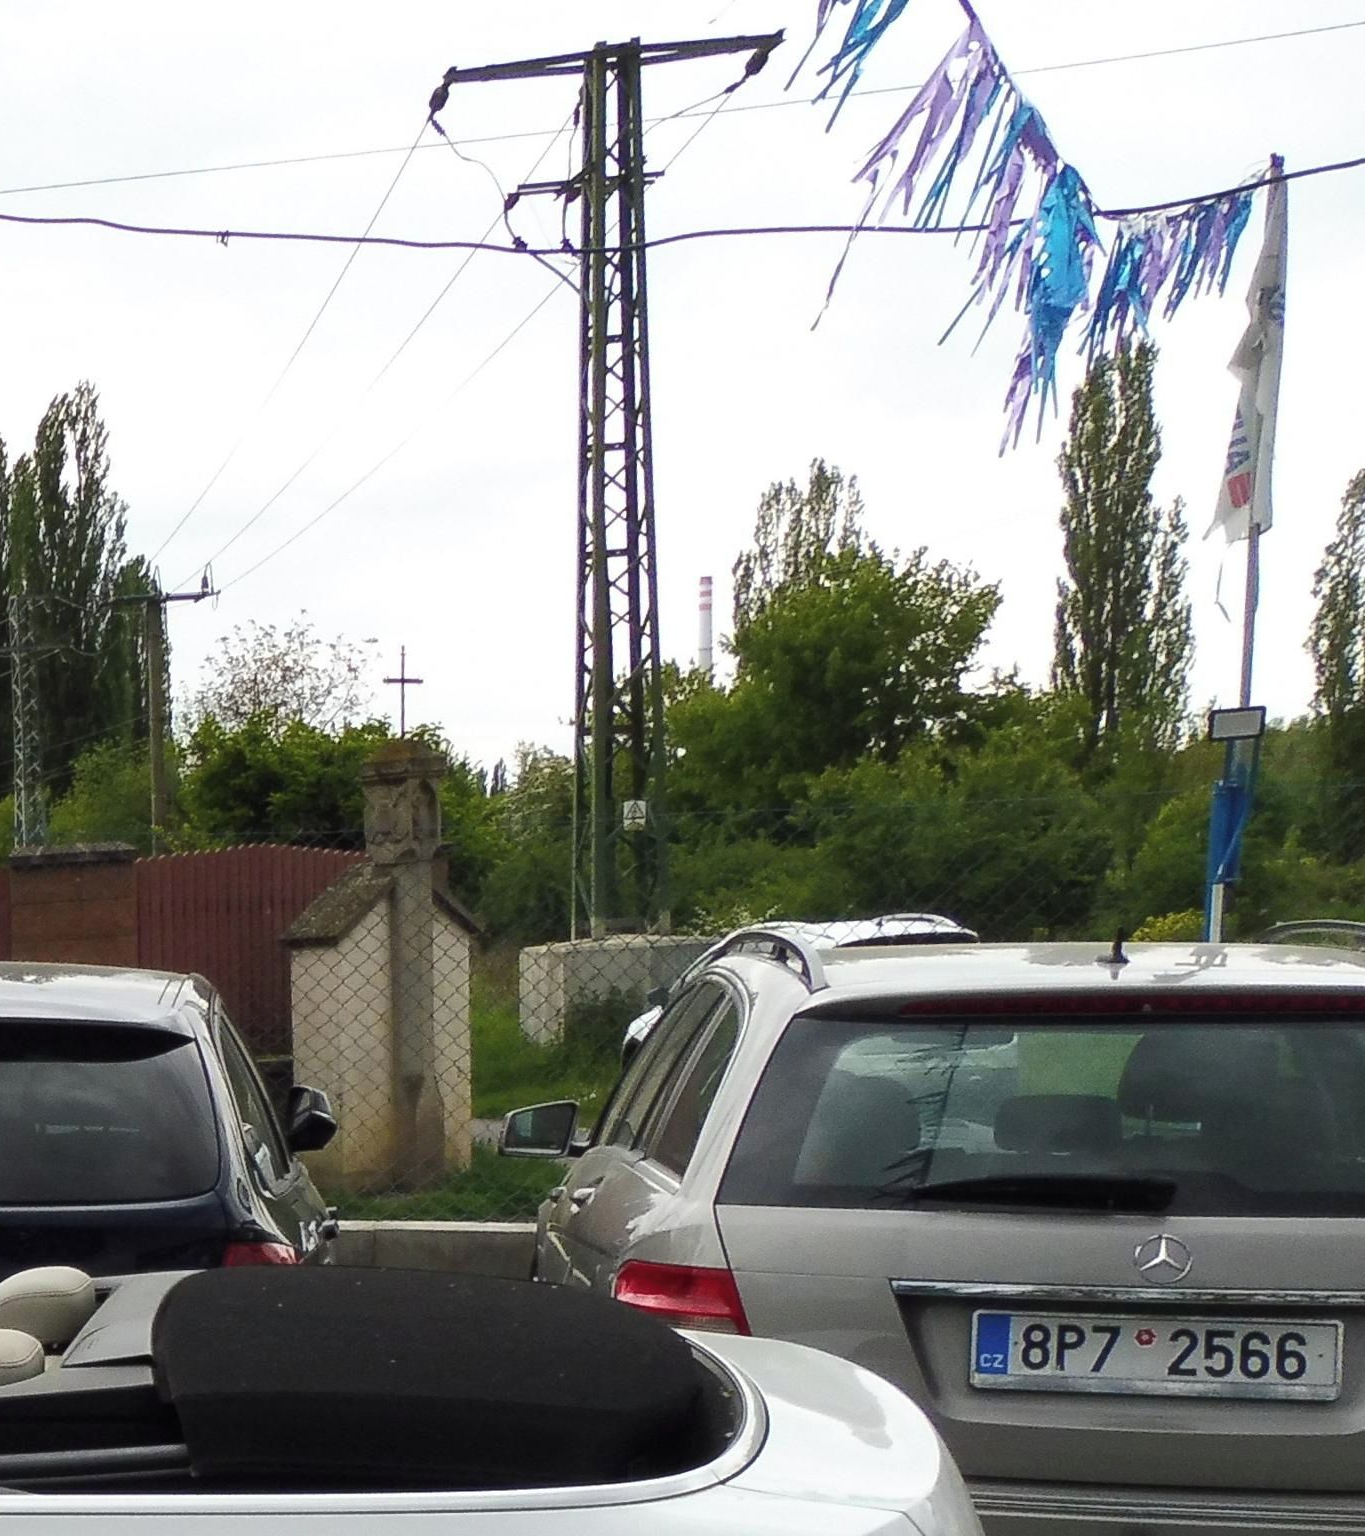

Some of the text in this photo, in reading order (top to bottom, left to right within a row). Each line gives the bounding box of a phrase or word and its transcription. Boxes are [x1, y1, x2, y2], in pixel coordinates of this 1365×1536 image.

[979, 1352, 1005, 1369] CZ
[1019, 1322, 1308, 1381] 8P7 2566
